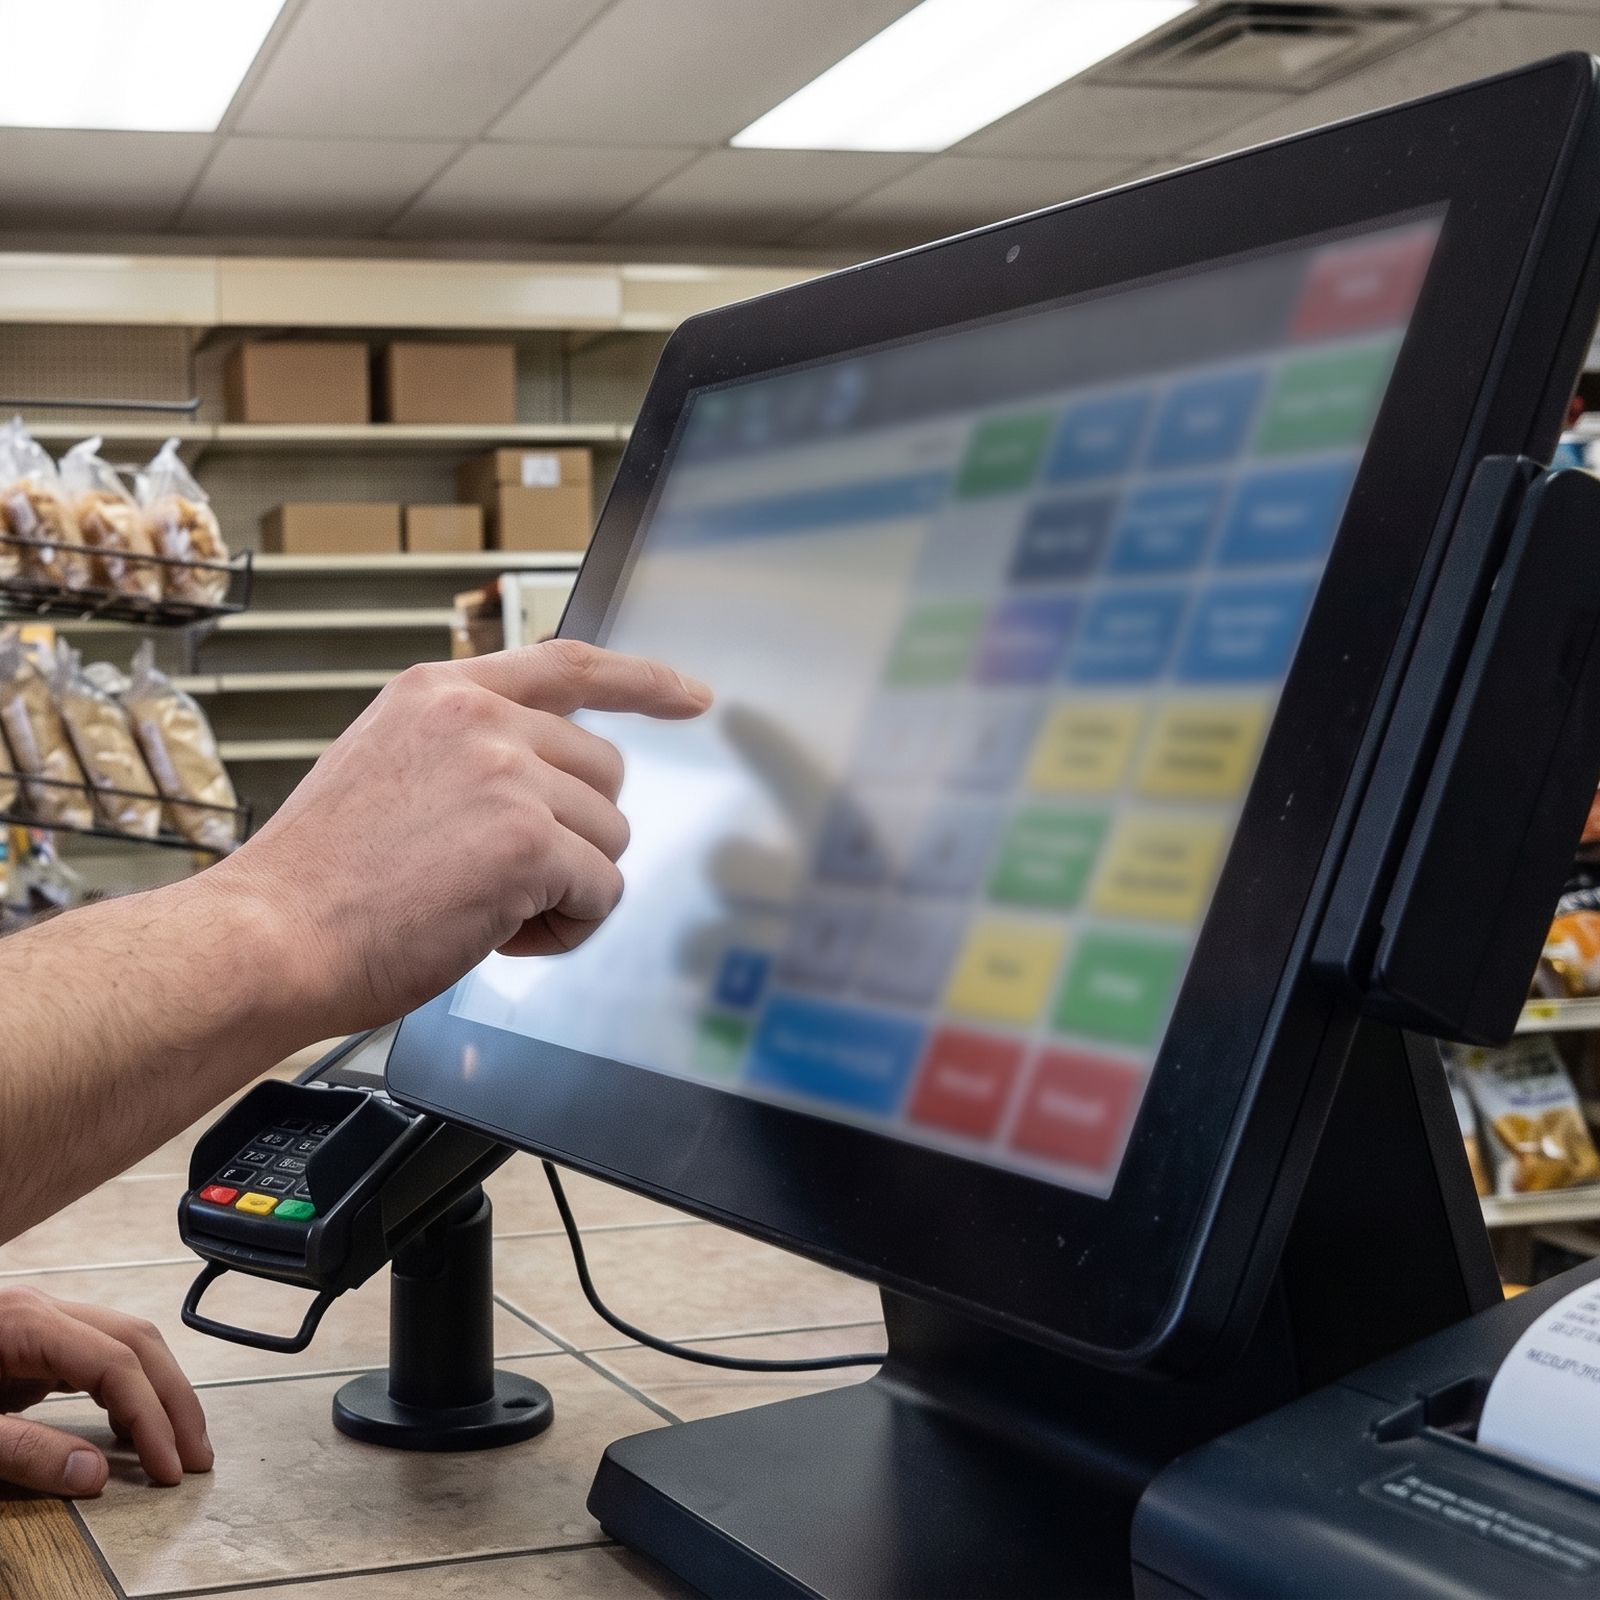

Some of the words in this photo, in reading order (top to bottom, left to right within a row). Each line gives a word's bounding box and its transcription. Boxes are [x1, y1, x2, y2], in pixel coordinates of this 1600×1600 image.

[316, 1124, 330, 1134] 2
[243, 1151, 257, 1160] 7
[260, 1176, 274, 1186] 0
